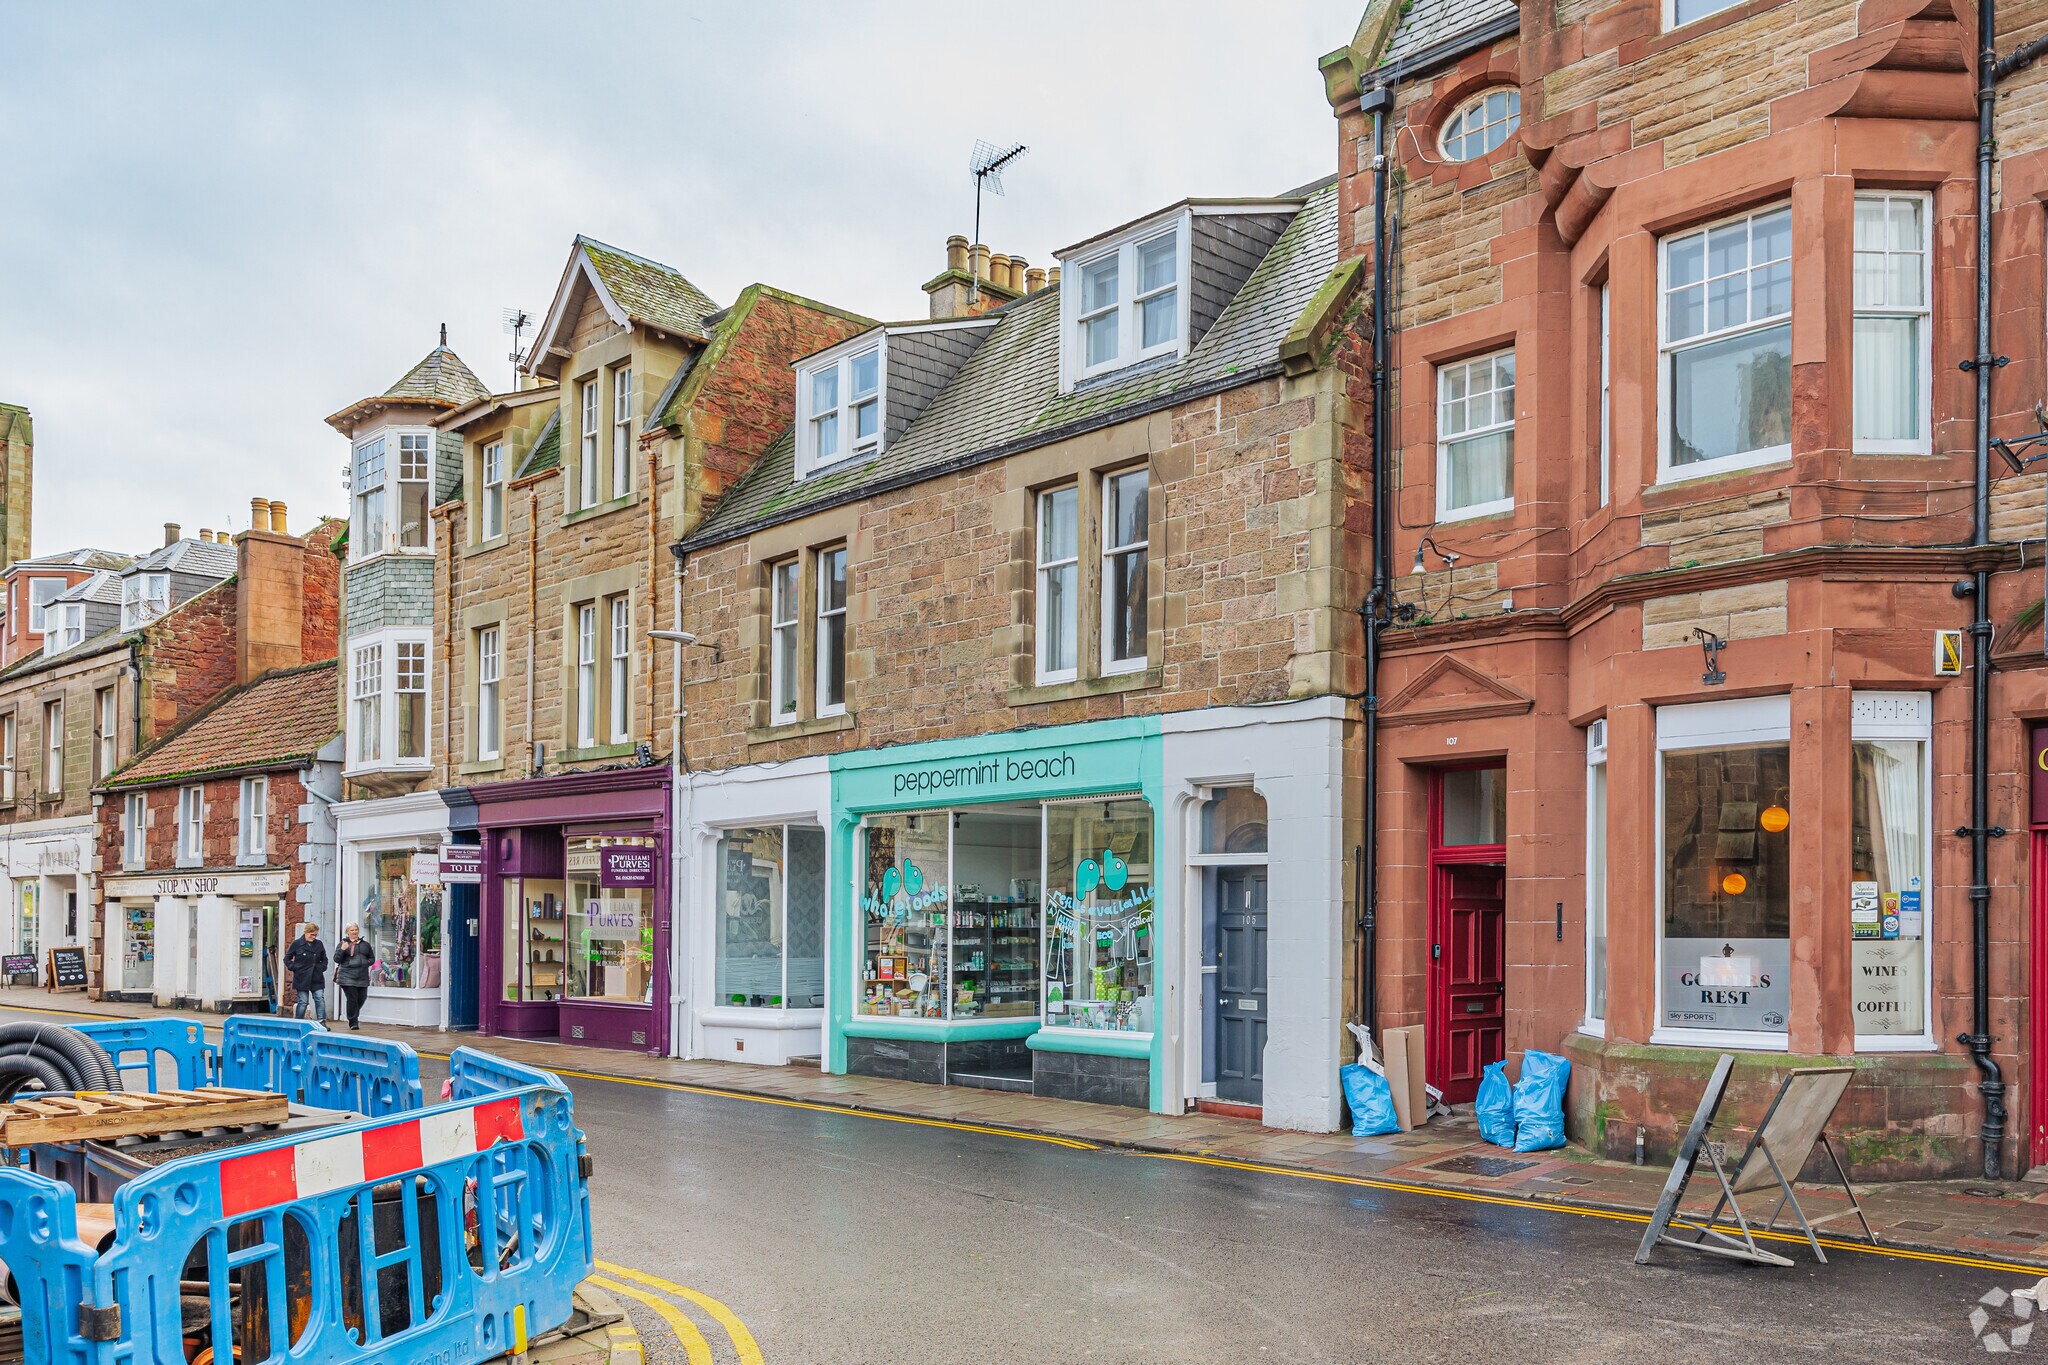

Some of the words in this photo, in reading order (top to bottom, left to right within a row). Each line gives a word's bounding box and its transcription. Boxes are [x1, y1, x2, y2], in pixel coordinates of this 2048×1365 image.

[1446, 737, 1457, 745] 107
[894, 758, 1000, 798] peppermint
[1006, 750, 1075, 782] beach
[450, 864, 462, 872] TO
[464, 864, 478, 872] LET
[610, 855, 648, 868] PURVES
[158, 879, 178, 893] STOP
[195, 877, 218, 892] SHOP
[859, 881, 948, 920] wholefoods
[1053, 890, 1086, 914] refills
[1088, 886, 1154, 917] available
[589, 902, 634, 928] PURVES
[1242, 915, 1256, 925] 105
[1096, 931, 1114, 940] ECO
[1681, 972, 1771, 989] GORS
[1700, 990, 1750, 1005] REST
[1670, 1012, 1681, 1020] sky
[1683, 1012, 1714, 1021] SPORTS
[454, 1337, 469, 1359] ltd
